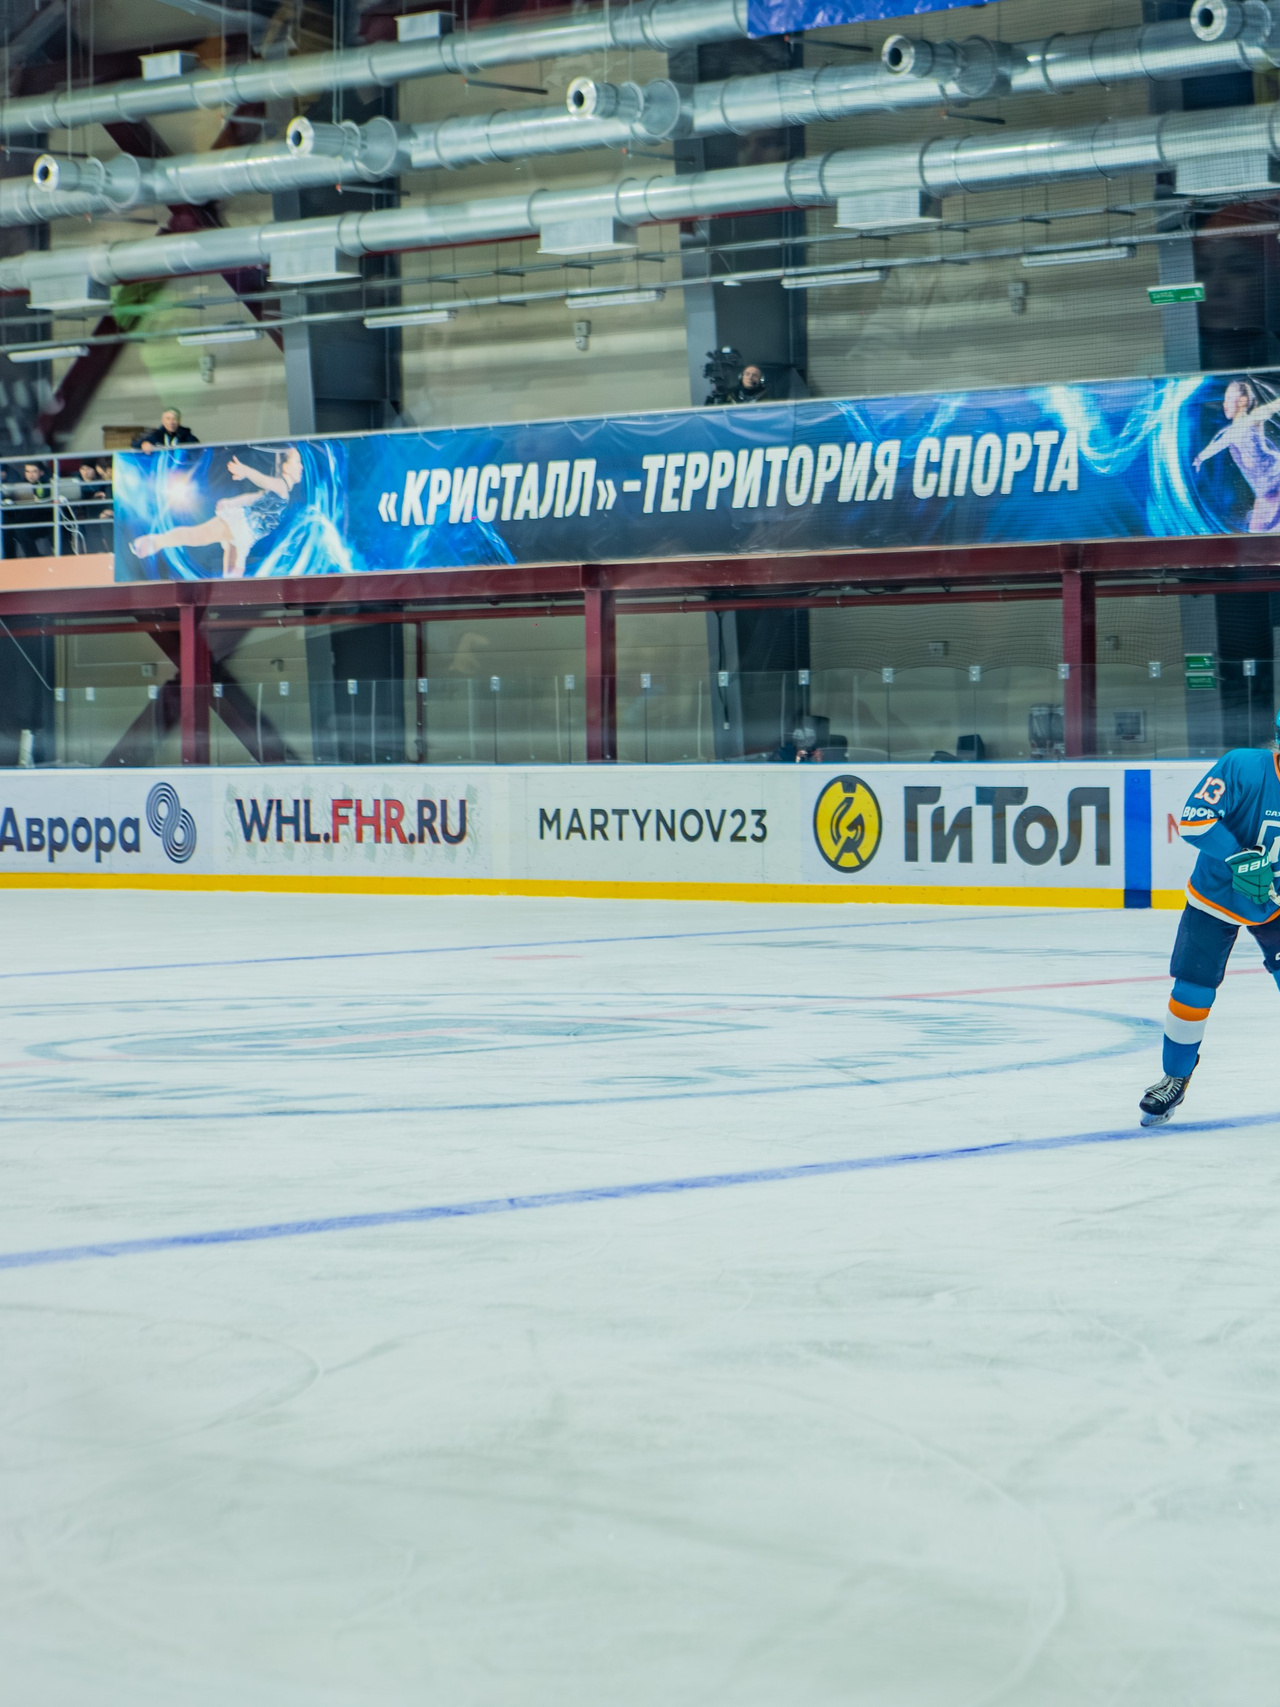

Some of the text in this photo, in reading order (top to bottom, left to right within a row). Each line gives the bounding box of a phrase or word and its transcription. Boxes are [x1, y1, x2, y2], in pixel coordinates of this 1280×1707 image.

[912, 431, 1080, 500] СПОРТА
[1194, 777, 1226, 805] 13
[0, 807, 141, 863] Аврора
[236, 799, 468, 844] WHL.FHR.RU
[539, 808, 768, 843] MARTYNOV23
